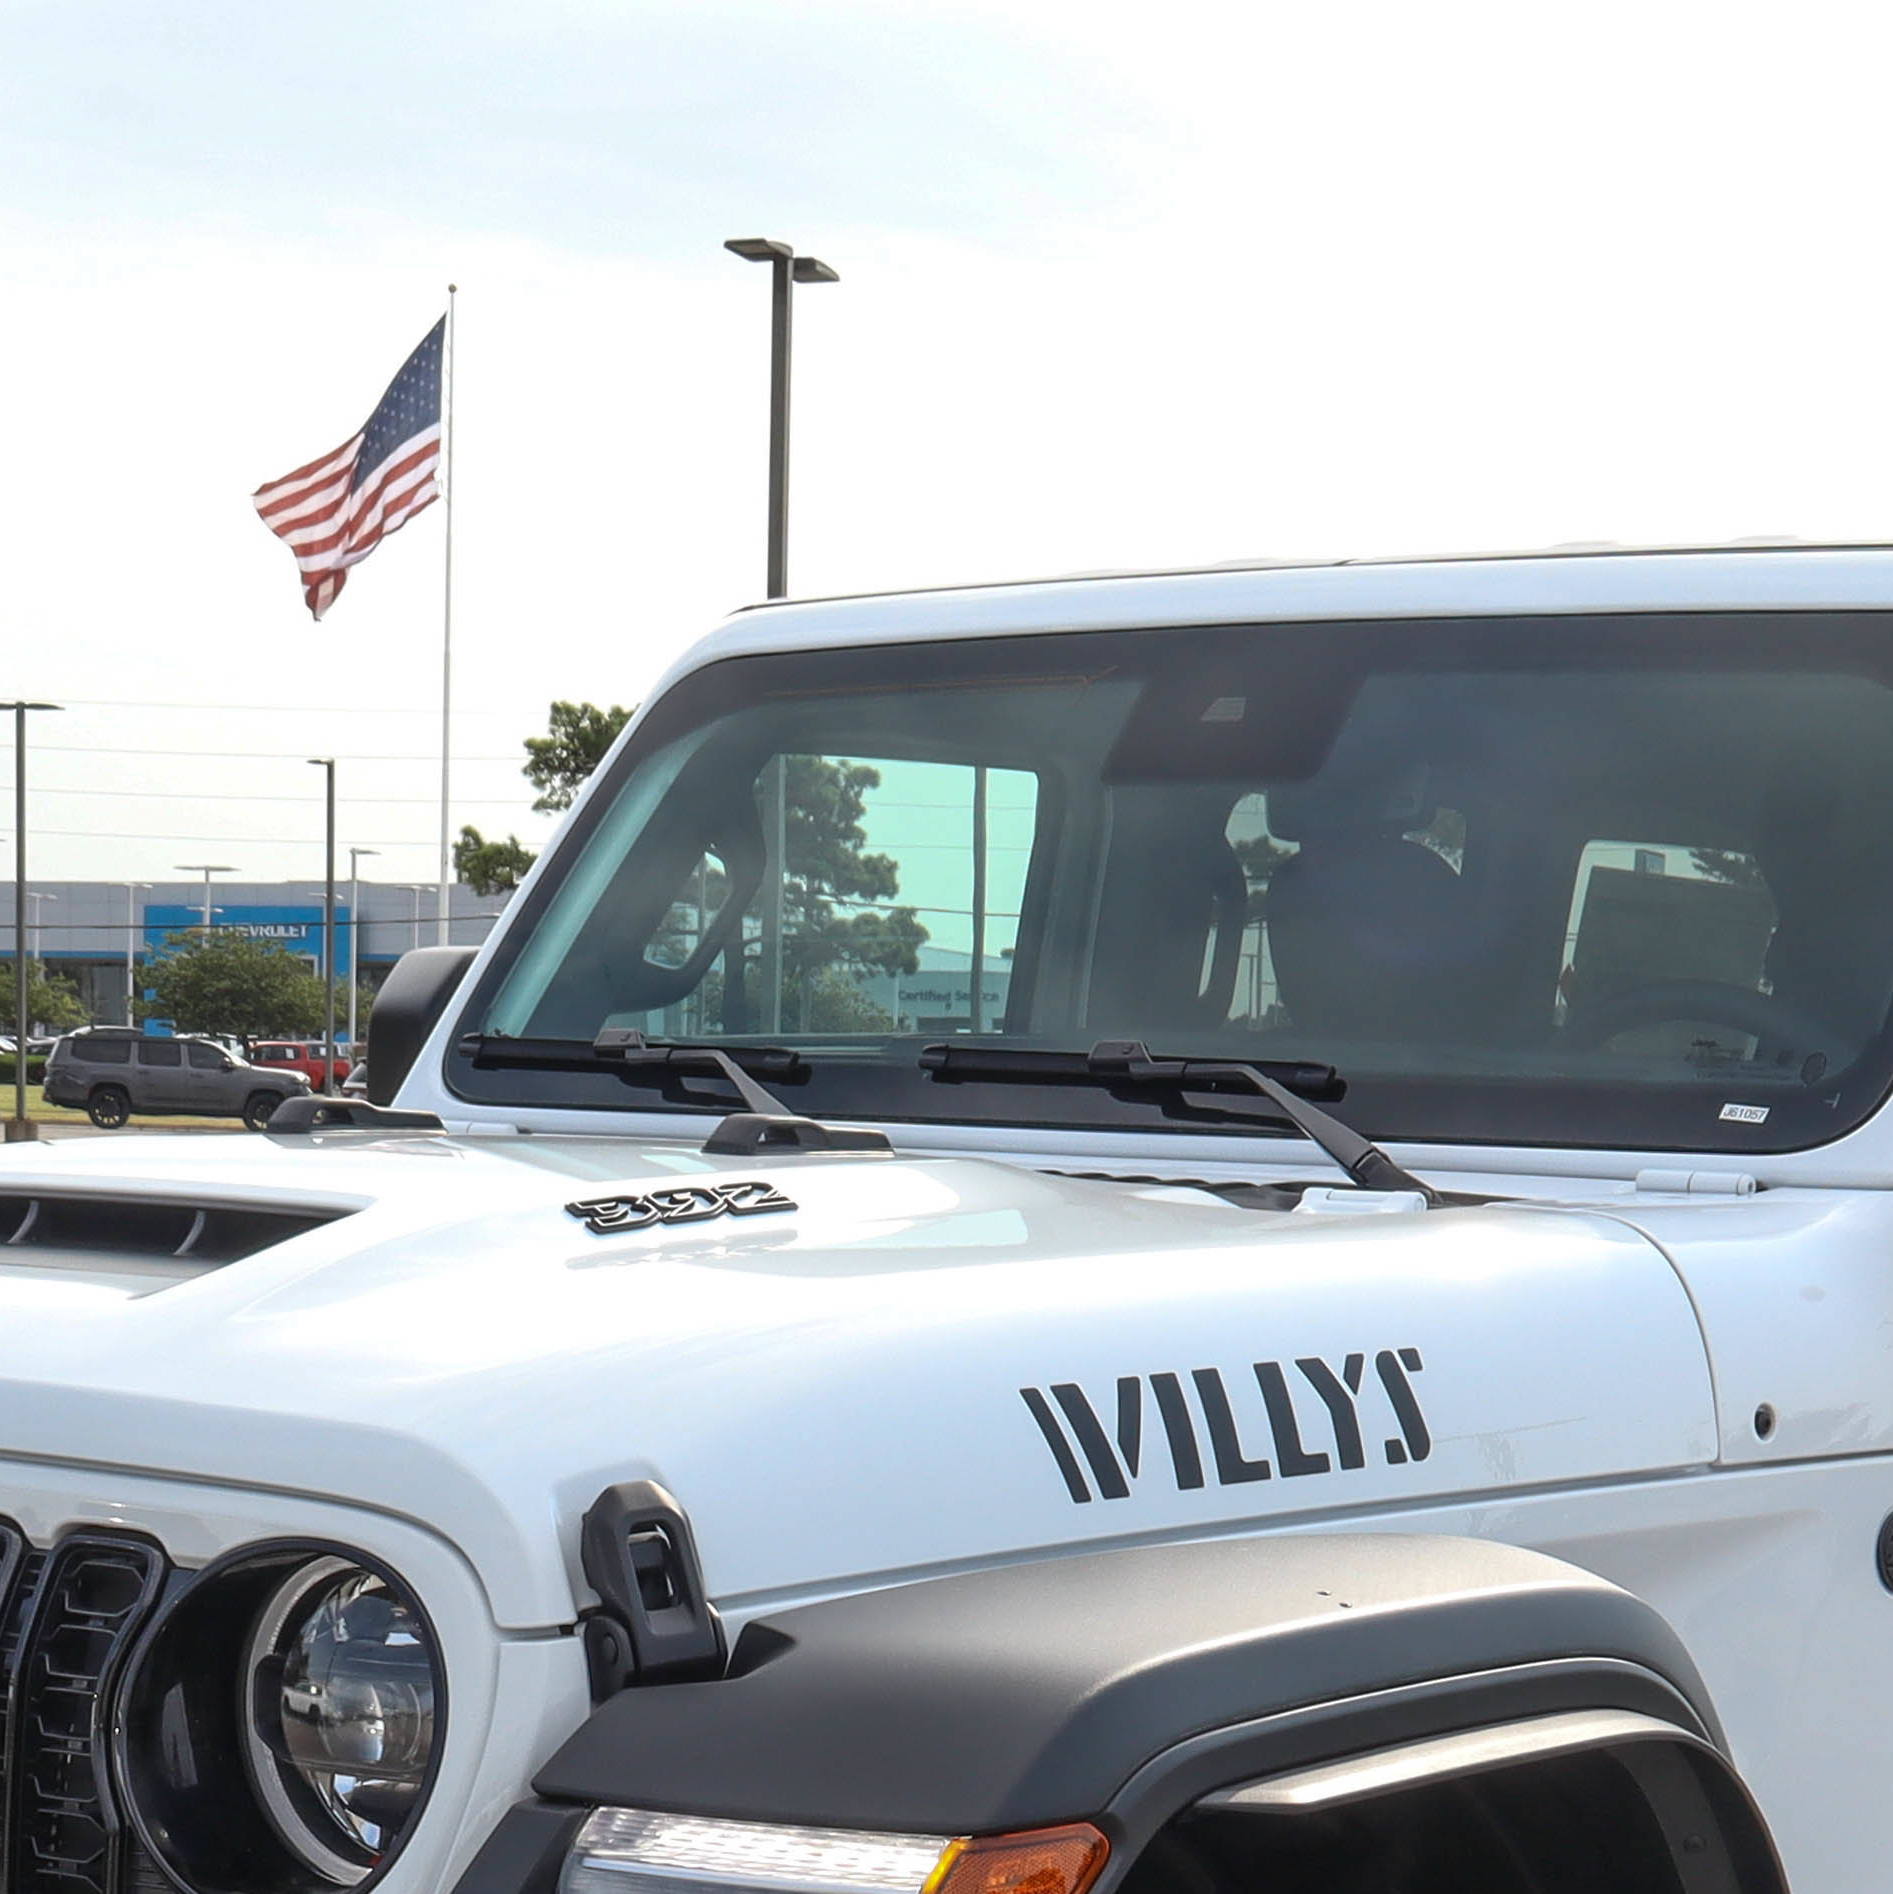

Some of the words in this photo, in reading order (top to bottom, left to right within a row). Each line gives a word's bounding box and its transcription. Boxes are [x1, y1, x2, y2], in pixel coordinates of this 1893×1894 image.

[898, 990, 951, 1001] Certified
[563, 1181, 800, 1236] 392
[1019, 1347, 1432, 1505] WILLYS
